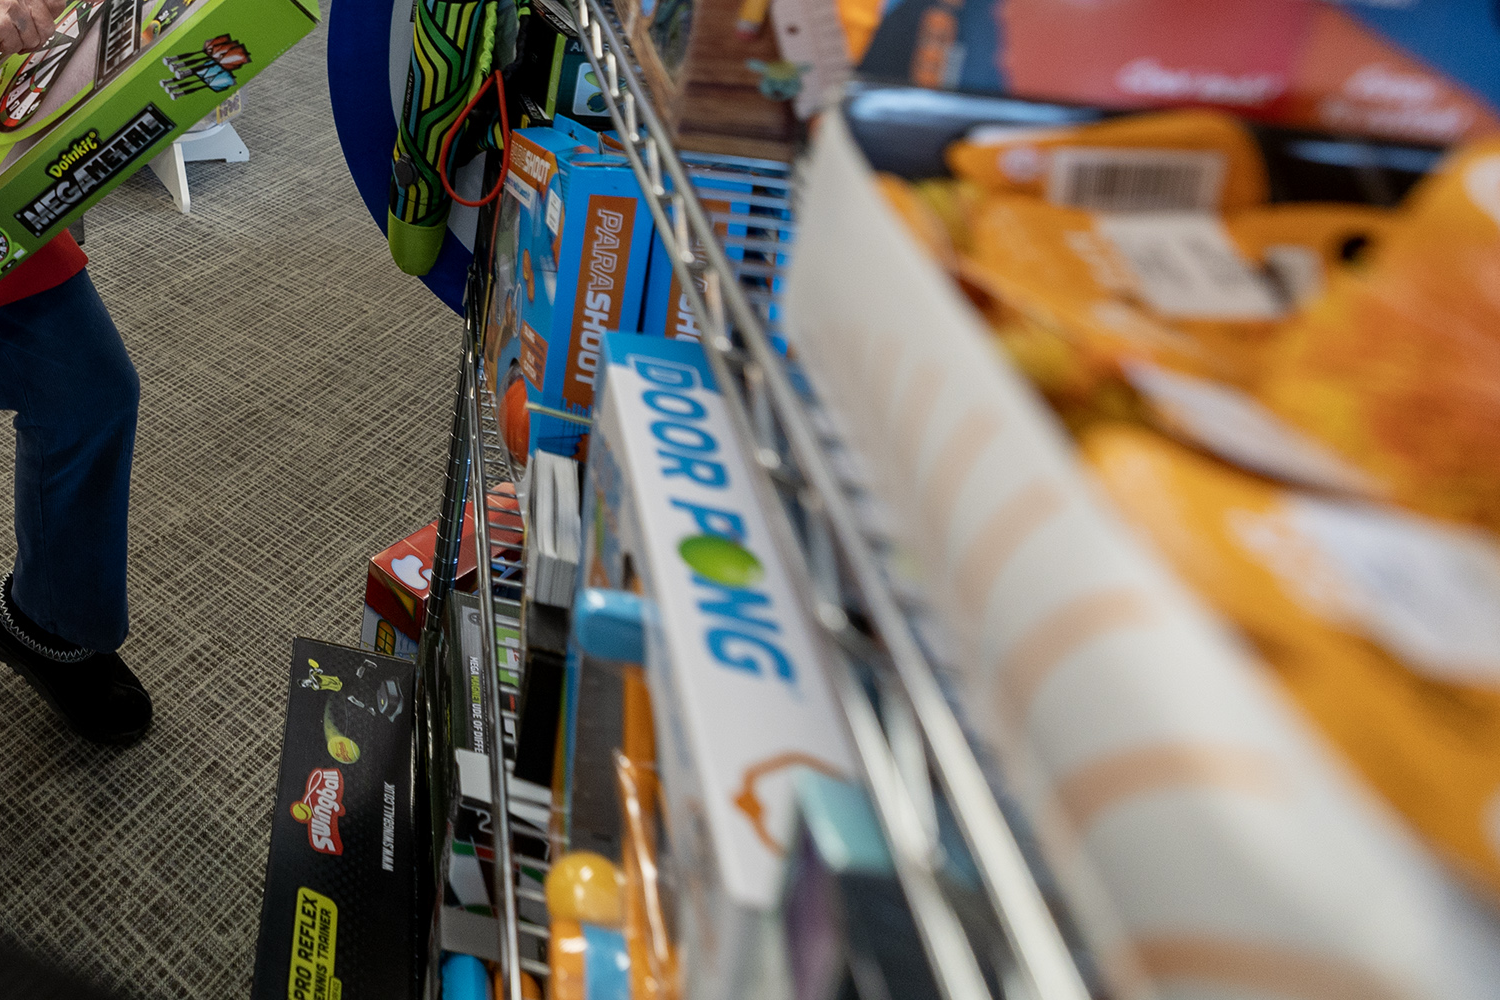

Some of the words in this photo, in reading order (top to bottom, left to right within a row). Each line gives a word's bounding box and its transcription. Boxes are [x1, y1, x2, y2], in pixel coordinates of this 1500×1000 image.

[23, 112, 166, 230] MEGAMETAL
[49, 135, 98, 178] Doinkit
[574, 207, 624, 389] PARASHOOT
[628, 353, 731, 490] DOOR
[473, 730, 484, 754] DIFFE
[475, 720, 483, 731] OF
[311, 770, 340, 852] Swingball
[381, 781, 396, 872] WWW.SWINGBALL.CO.UK
[296, 893, 319, 963] REFLEX
[316, 907, 332, 958] TRAINER
[294, 966, 313, 1000] PRO
